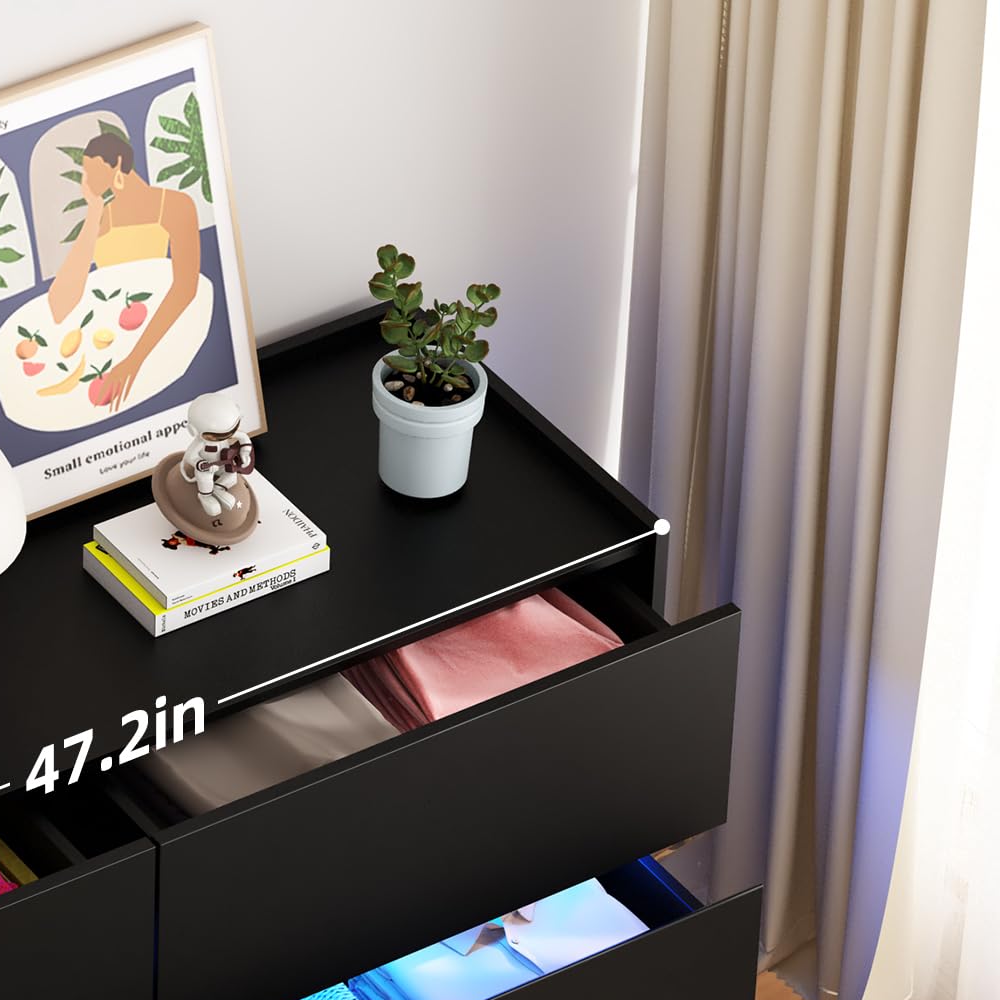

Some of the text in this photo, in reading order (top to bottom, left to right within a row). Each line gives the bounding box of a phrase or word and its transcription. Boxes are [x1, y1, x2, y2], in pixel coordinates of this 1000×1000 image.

[44, 457, 82, 480] Small
[85, 431, 152, 464] emotional
[99, 451, 150, 475] Love your life
[184, 597, 225, 619] MOVIES
[225, 588, 248, 603] AND
[248, 569, 297, 594] METHODS
[270, 579, 293, 590] Volume
